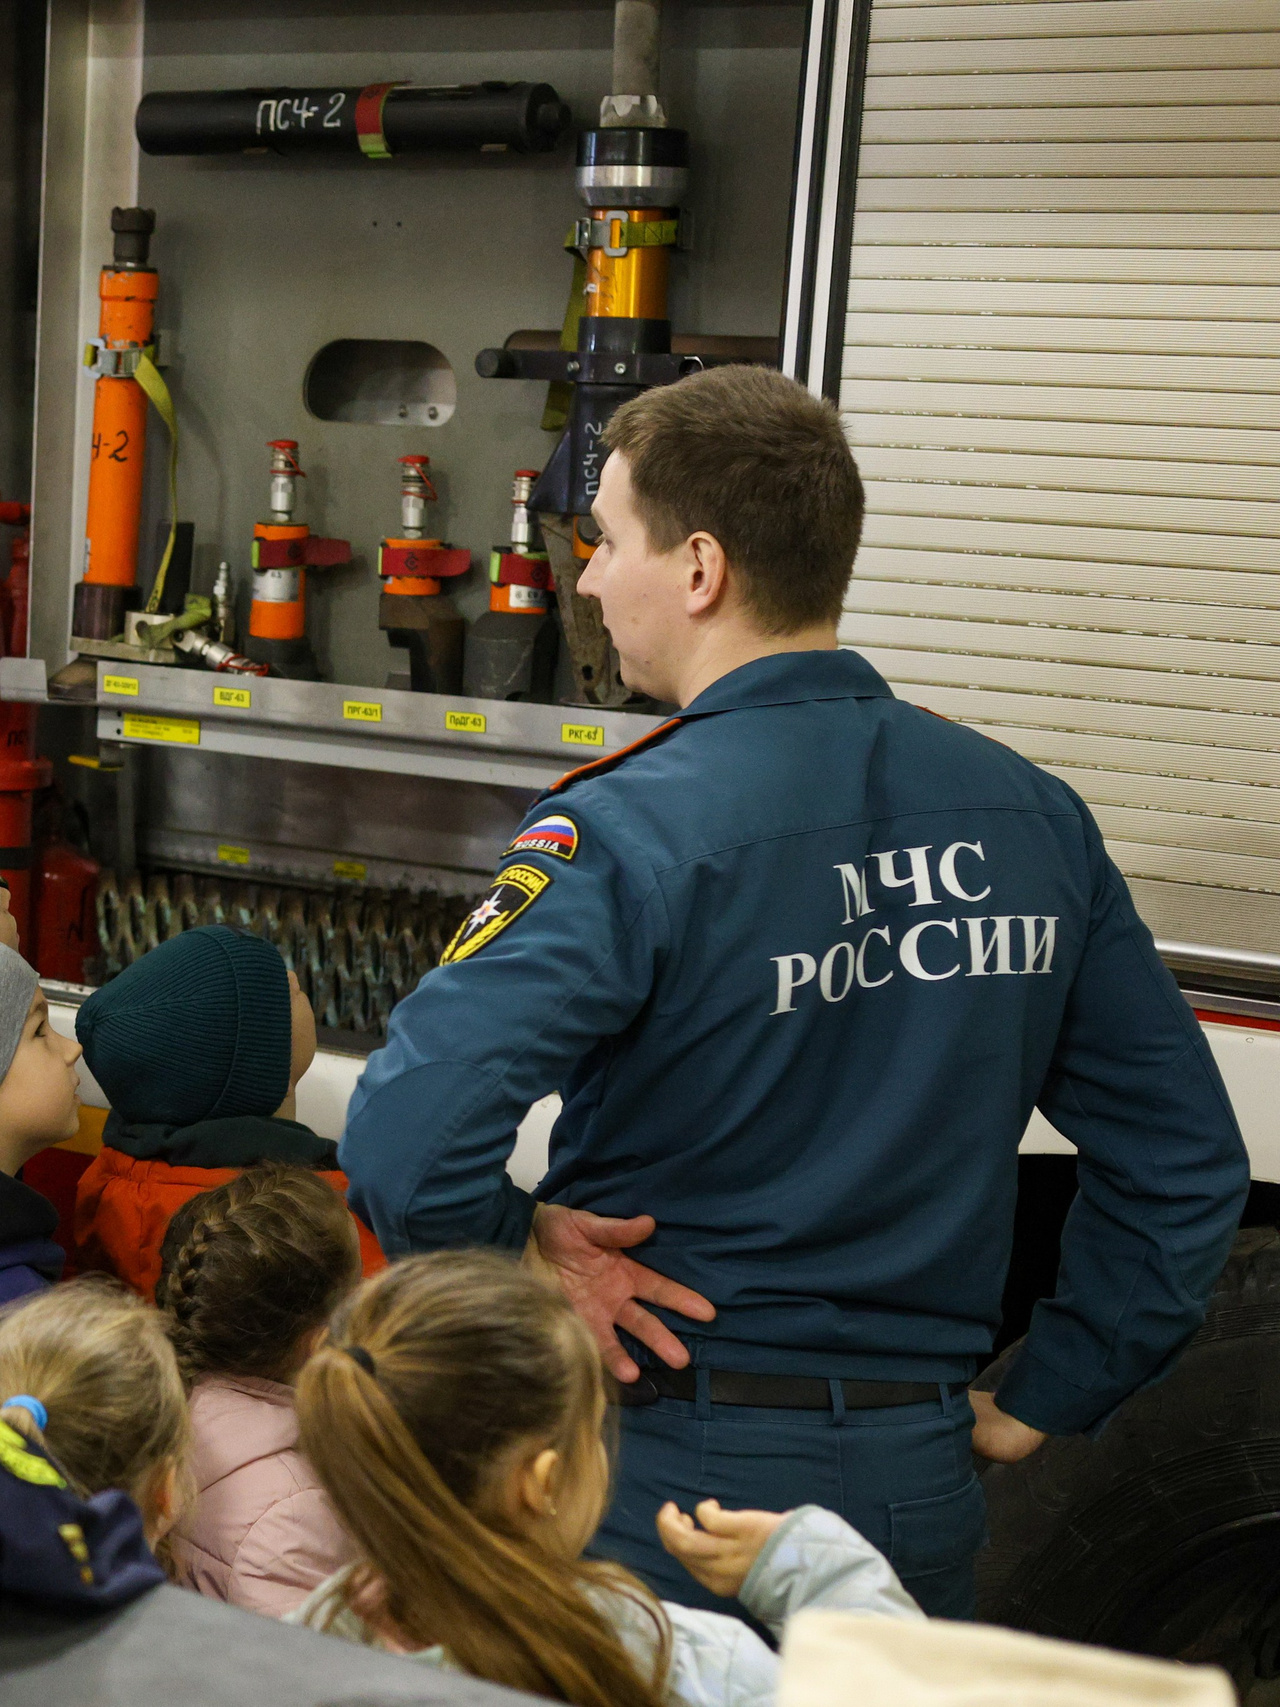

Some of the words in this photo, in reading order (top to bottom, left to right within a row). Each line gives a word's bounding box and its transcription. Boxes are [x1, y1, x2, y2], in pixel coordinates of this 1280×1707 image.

[513, 838, 560, 852] RUSSIA
[833, 841, 991, 925] МЧС
[769, 915, 1060, 1016] РОССИИ
